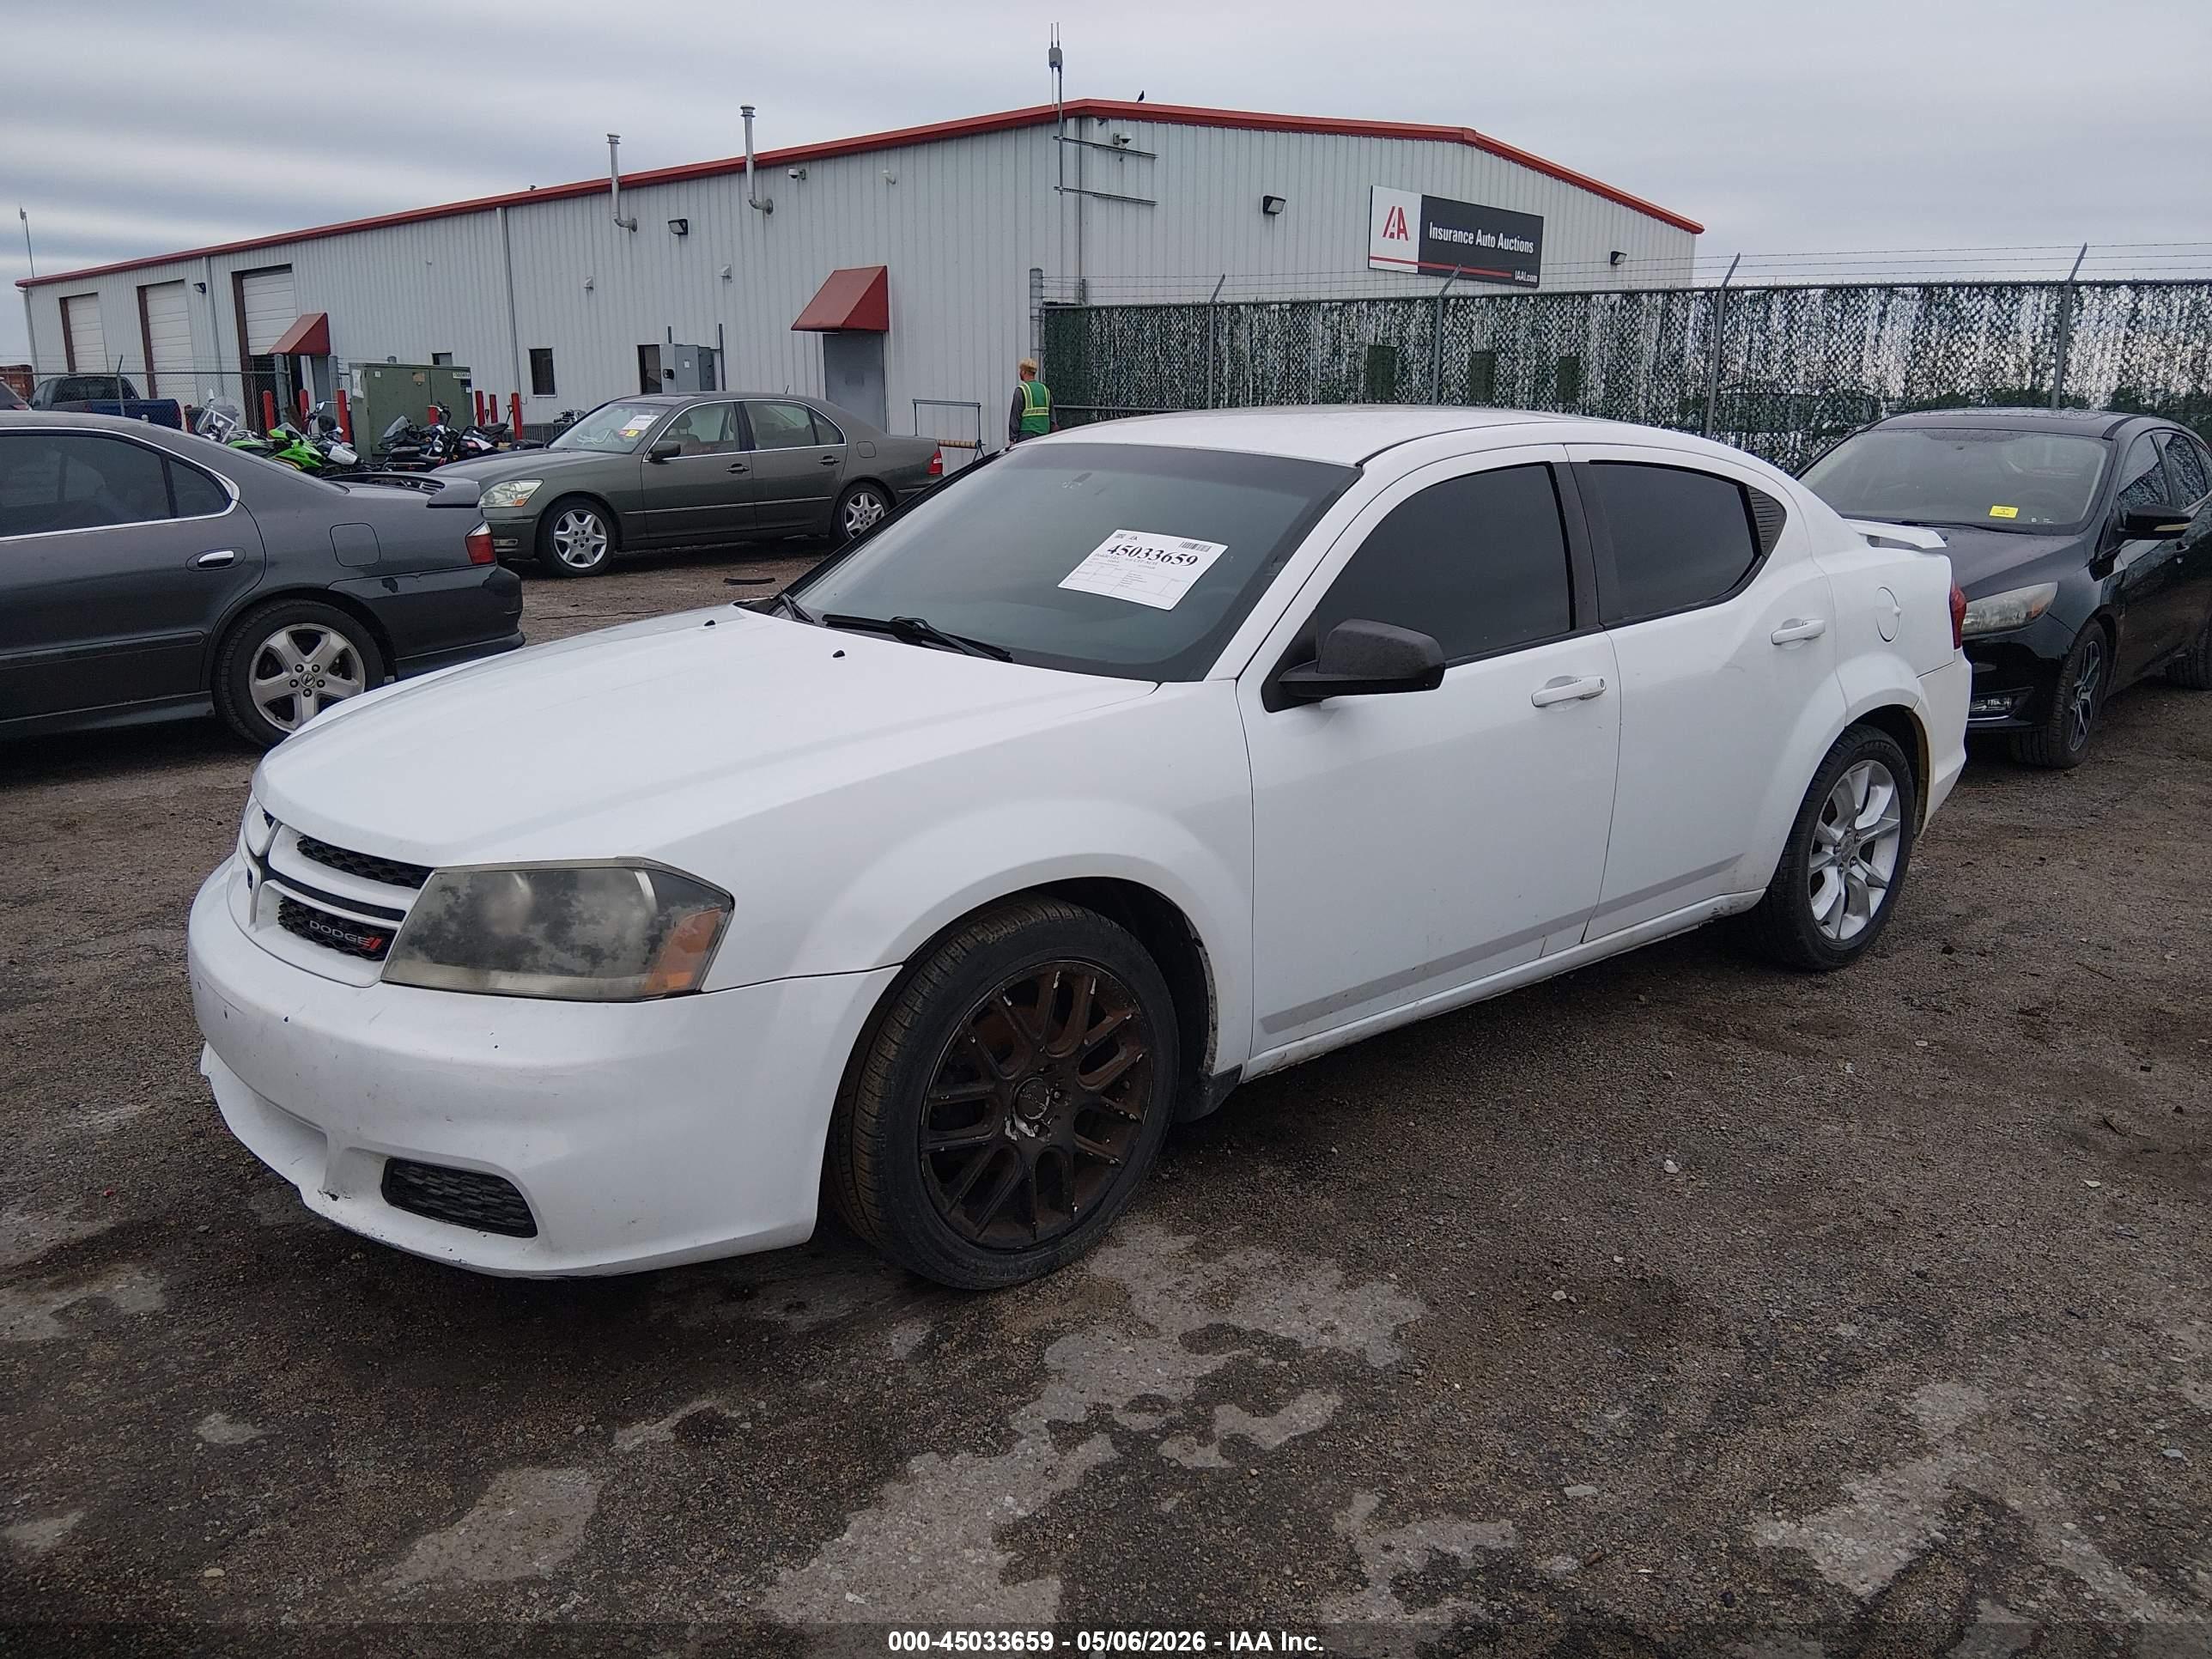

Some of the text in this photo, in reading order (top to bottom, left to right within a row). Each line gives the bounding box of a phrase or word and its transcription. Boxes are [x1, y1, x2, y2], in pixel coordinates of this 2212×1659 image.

[1429, 222, 1534, 254] Insurance Auto Auctions
[1107, 544, 1199, 567] 45033659
[309, 920, 371, 946] DODGE
